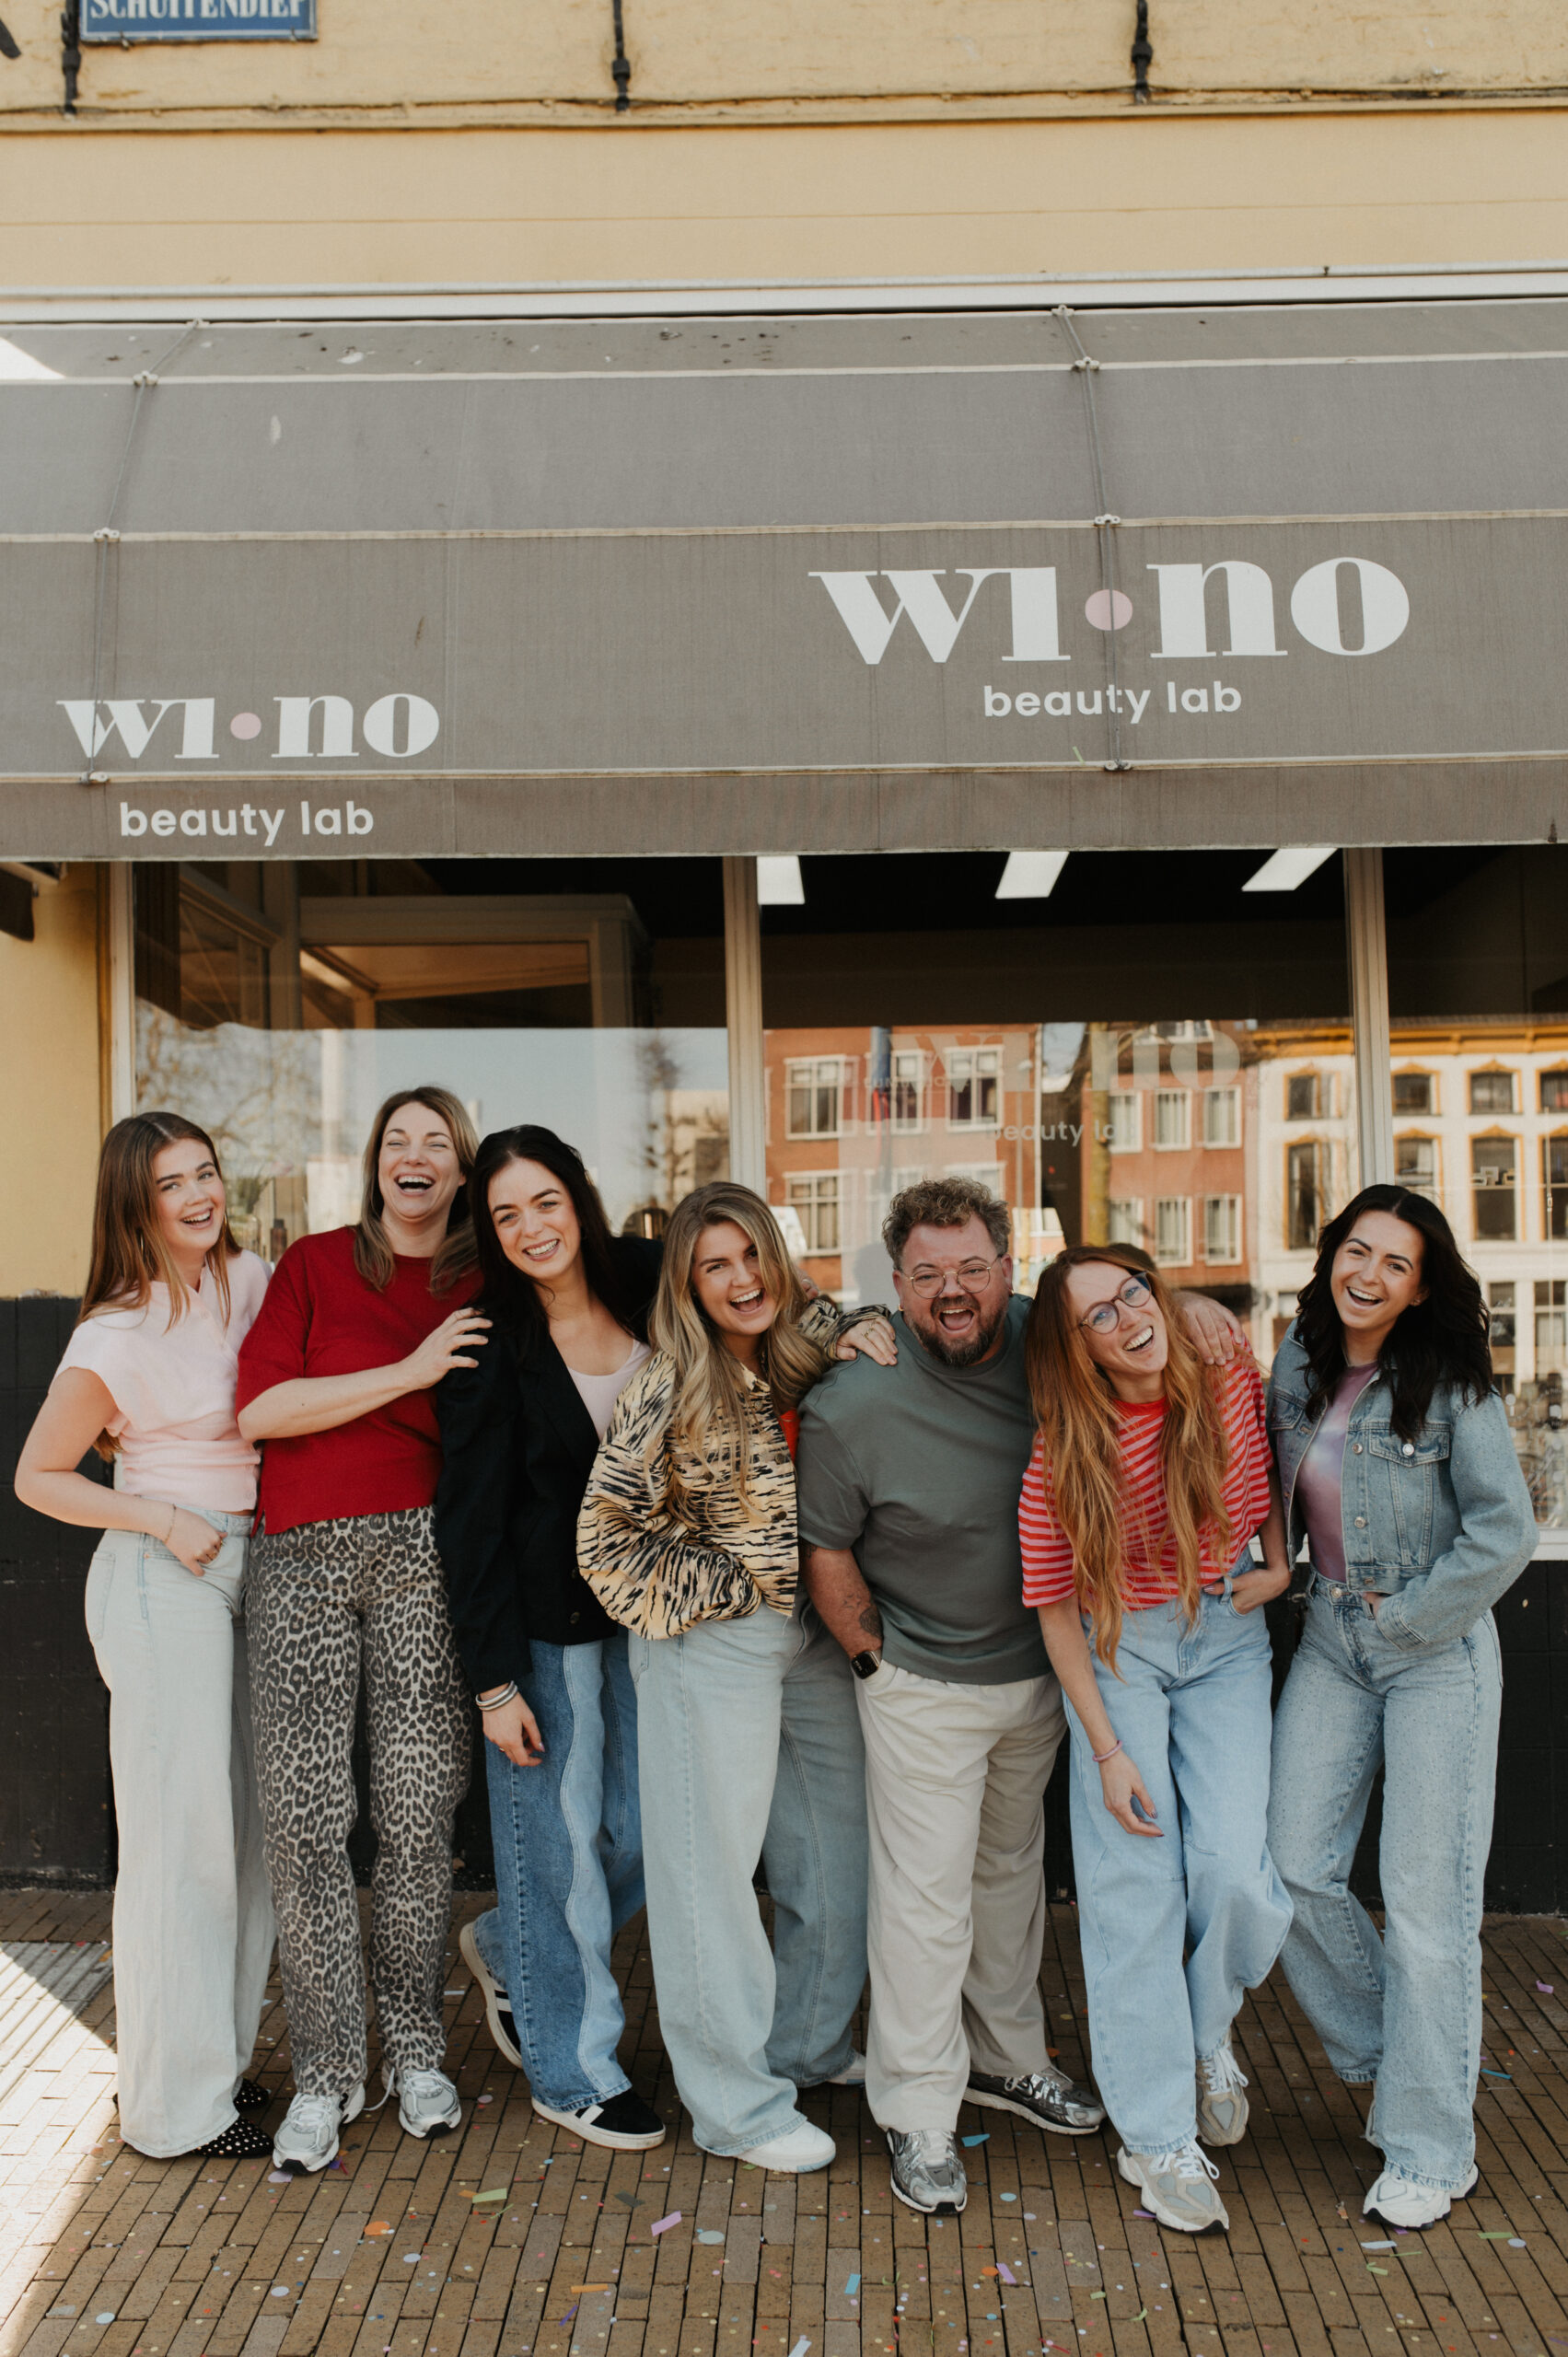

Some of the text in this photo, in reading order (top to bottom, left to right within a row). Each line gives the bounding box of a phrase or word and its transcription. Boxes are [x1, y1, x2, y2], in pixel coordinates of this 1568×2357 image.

[983, 680, 1242, 724] beauty lab
[120, 800, 374, 846] beauty lab
